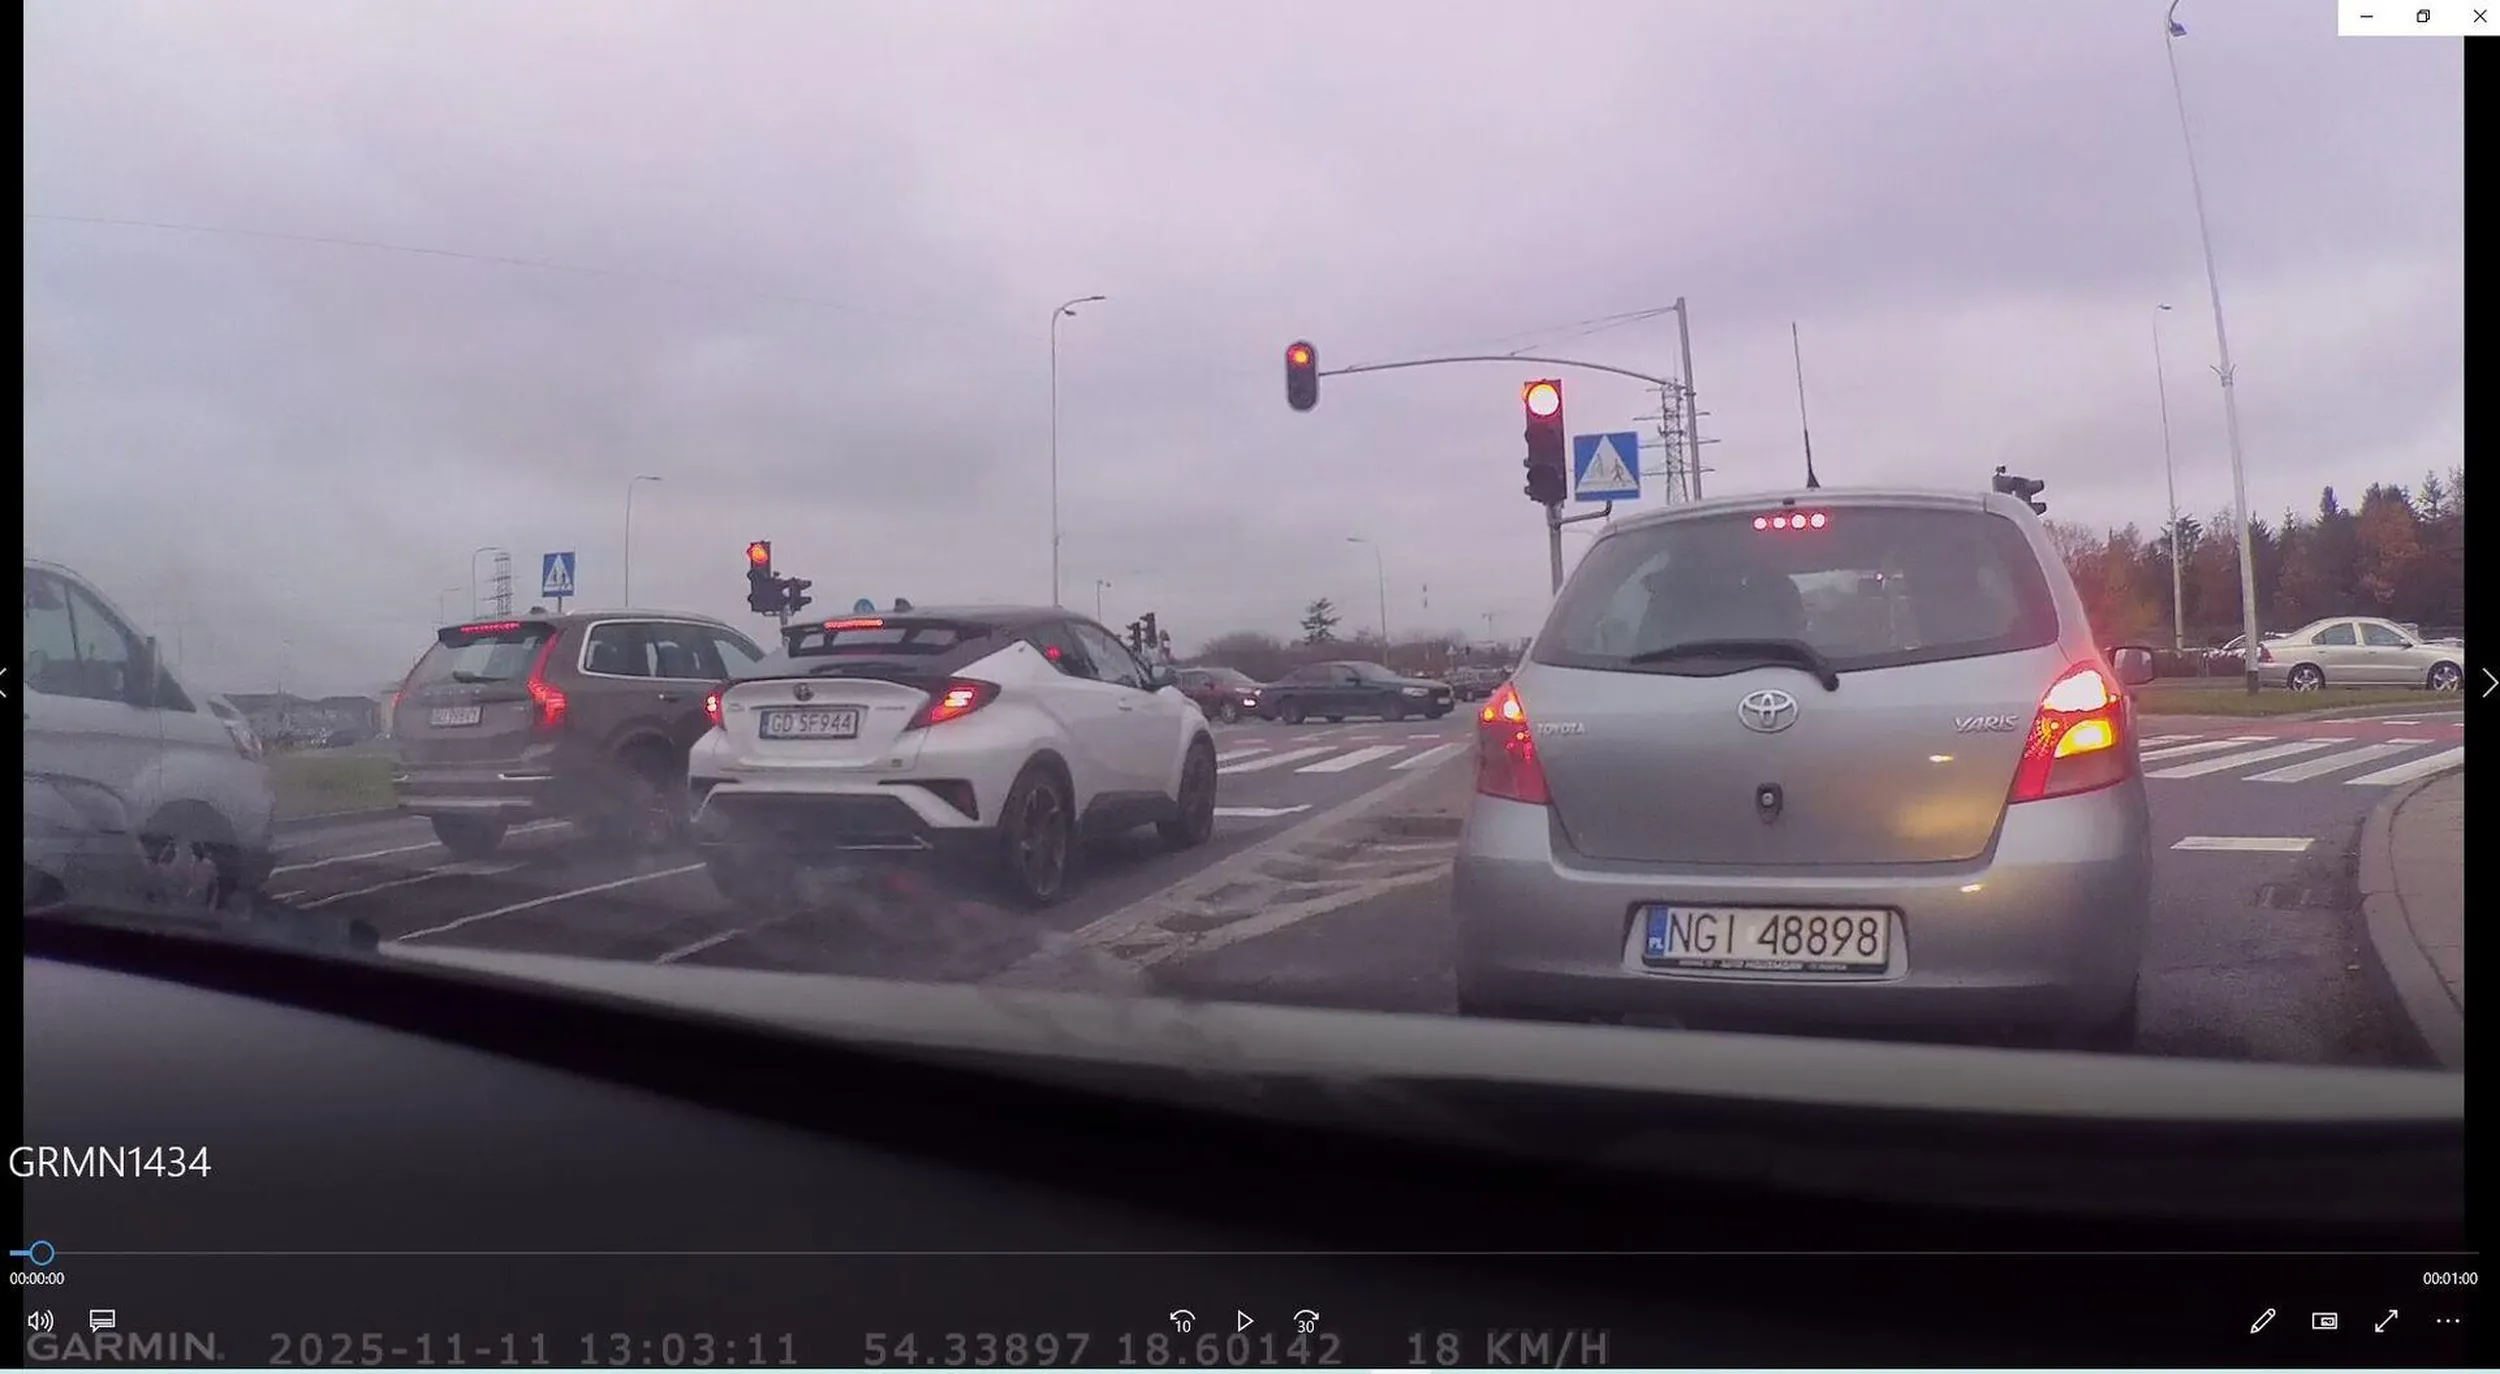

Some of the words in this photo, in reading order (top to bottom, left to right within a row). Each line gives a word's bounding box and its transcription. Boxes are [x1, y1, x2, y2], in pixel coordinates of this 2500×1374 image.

[772, 713, 794, 733] GD
[1954, 714, 2019, 733] YARIS
[1668, 912, 1734, 954] NGI
[1757, 914, 1879, 957] 48898
